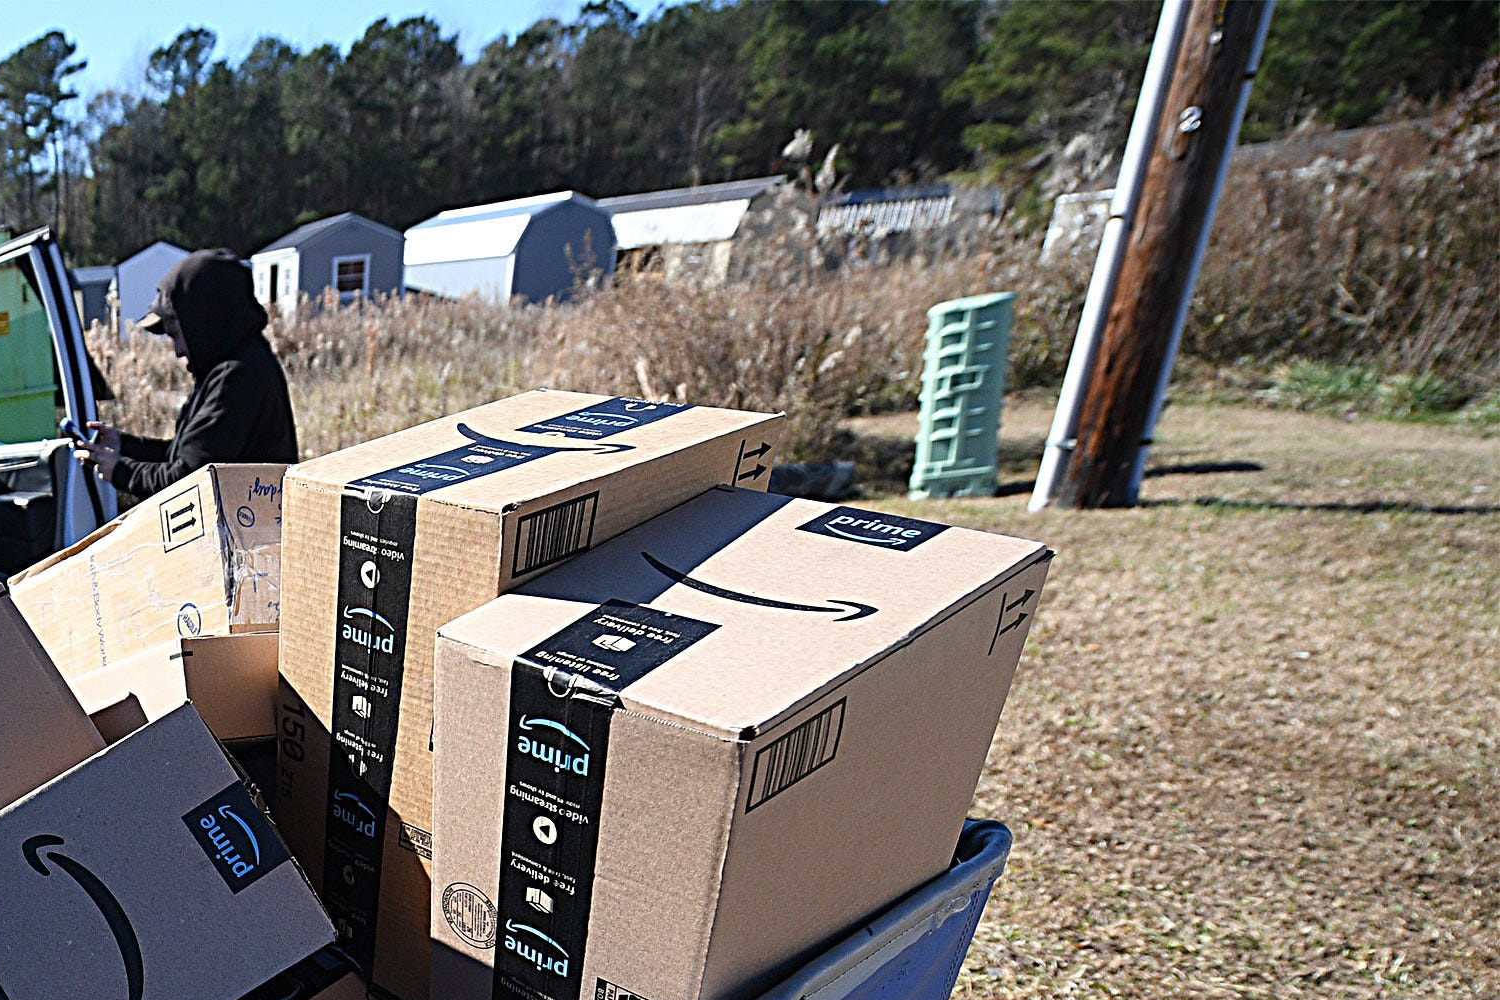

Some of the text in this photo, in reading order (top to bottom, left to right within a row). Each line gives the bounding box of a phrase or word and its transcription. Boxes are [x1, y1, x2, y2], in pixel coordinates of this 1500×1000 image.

[565, 415, 637, 427] prime
[398, 466, 466, 481] prime
[828, 515, 922, 538] prime
[381, 548, 405, 562] video
[93, 592, 103, 628] Body
[342, 624, 395, 654] prime
[593, 618, 674, 645] free delivery
[535, 650, 620, 681] free listening
[370, 685, 389, 698] free
[517, 735, 590, 777] prime
[509, 784, 589, 825] video streaming
[333, 803, 376, 838] prme
[200, 814, 254, 878] prime
[510, 858, 575, 896] free delivery
[504, 934, 569, 977] prime
